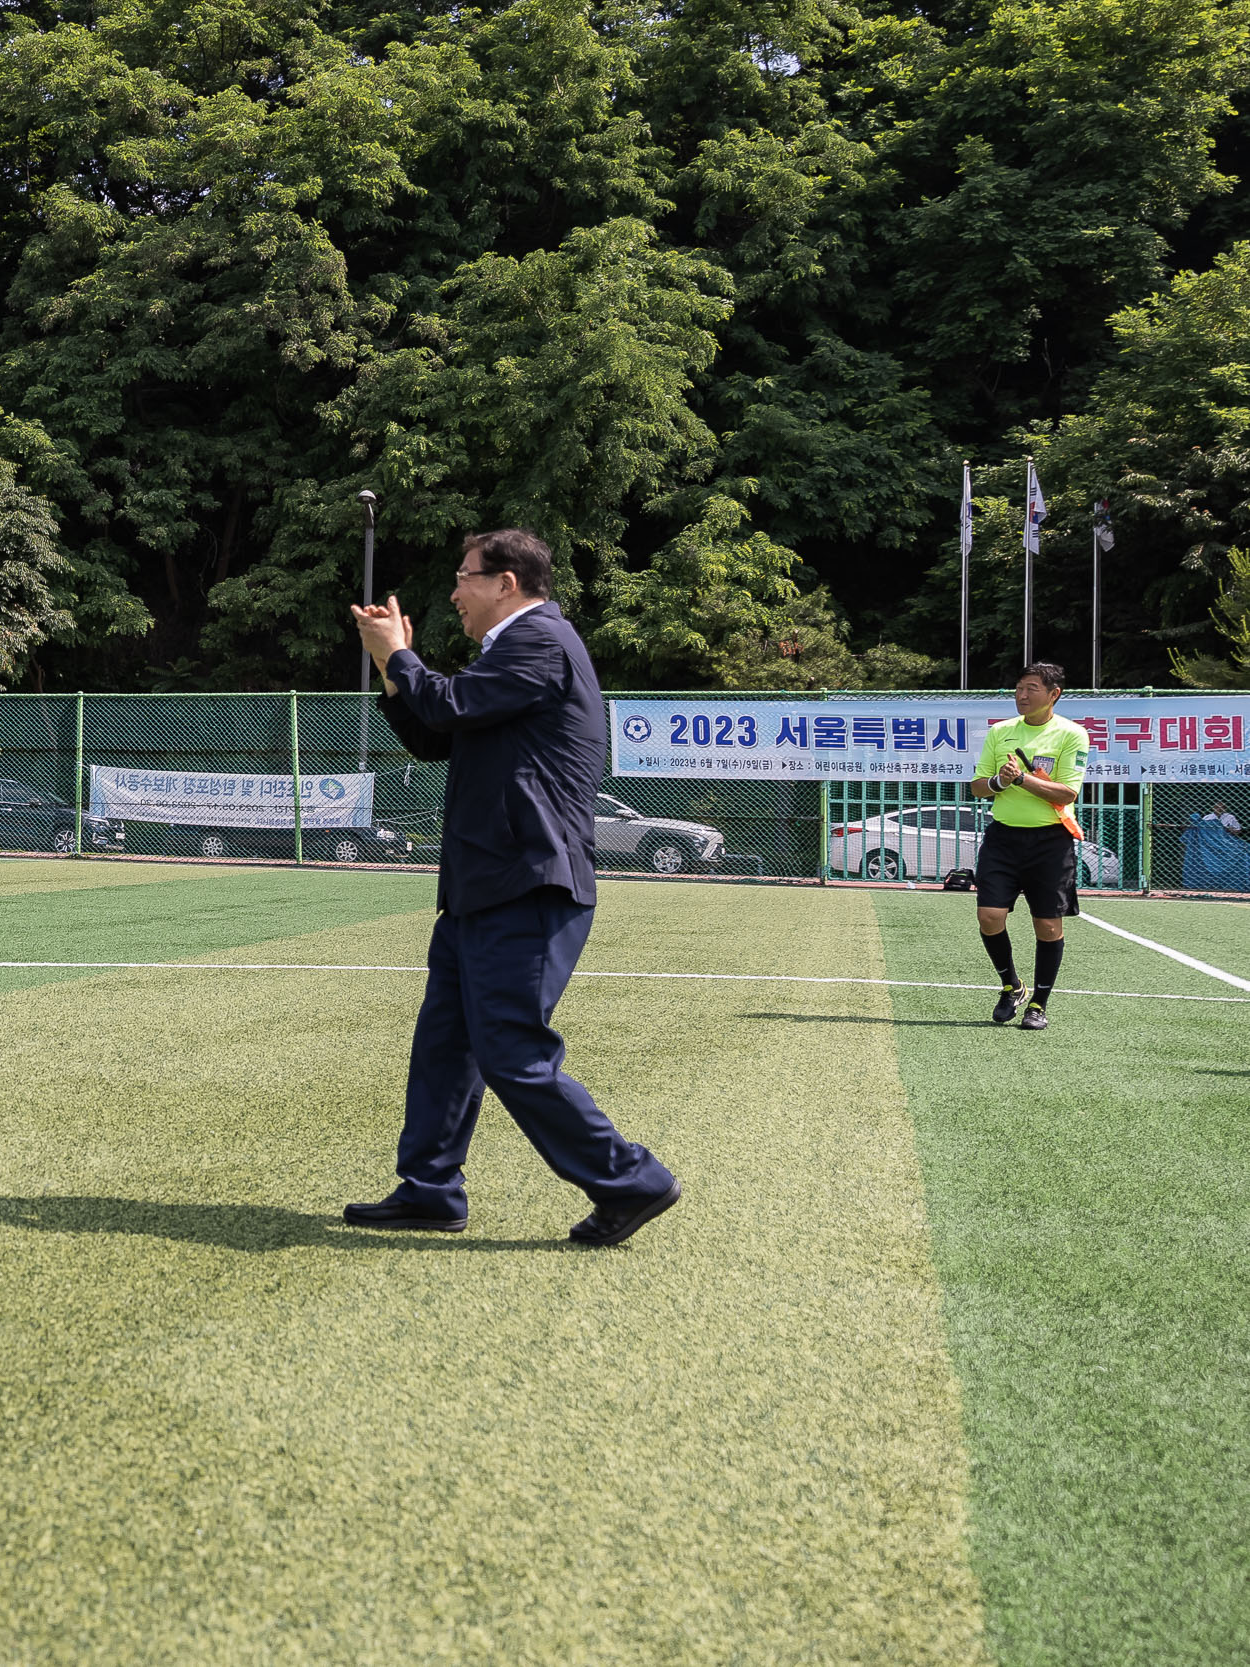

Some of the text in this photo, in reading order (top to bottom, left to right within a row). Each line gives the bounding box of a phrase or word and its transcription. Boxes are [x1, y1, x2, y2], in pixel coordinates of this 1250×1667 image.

[669, 714, 757, 748] 2023
[774, 715, 968, 752] 서울특별시
[670, 757, 696, 768] 2023년
[700, 758, 712, 769] 6월
